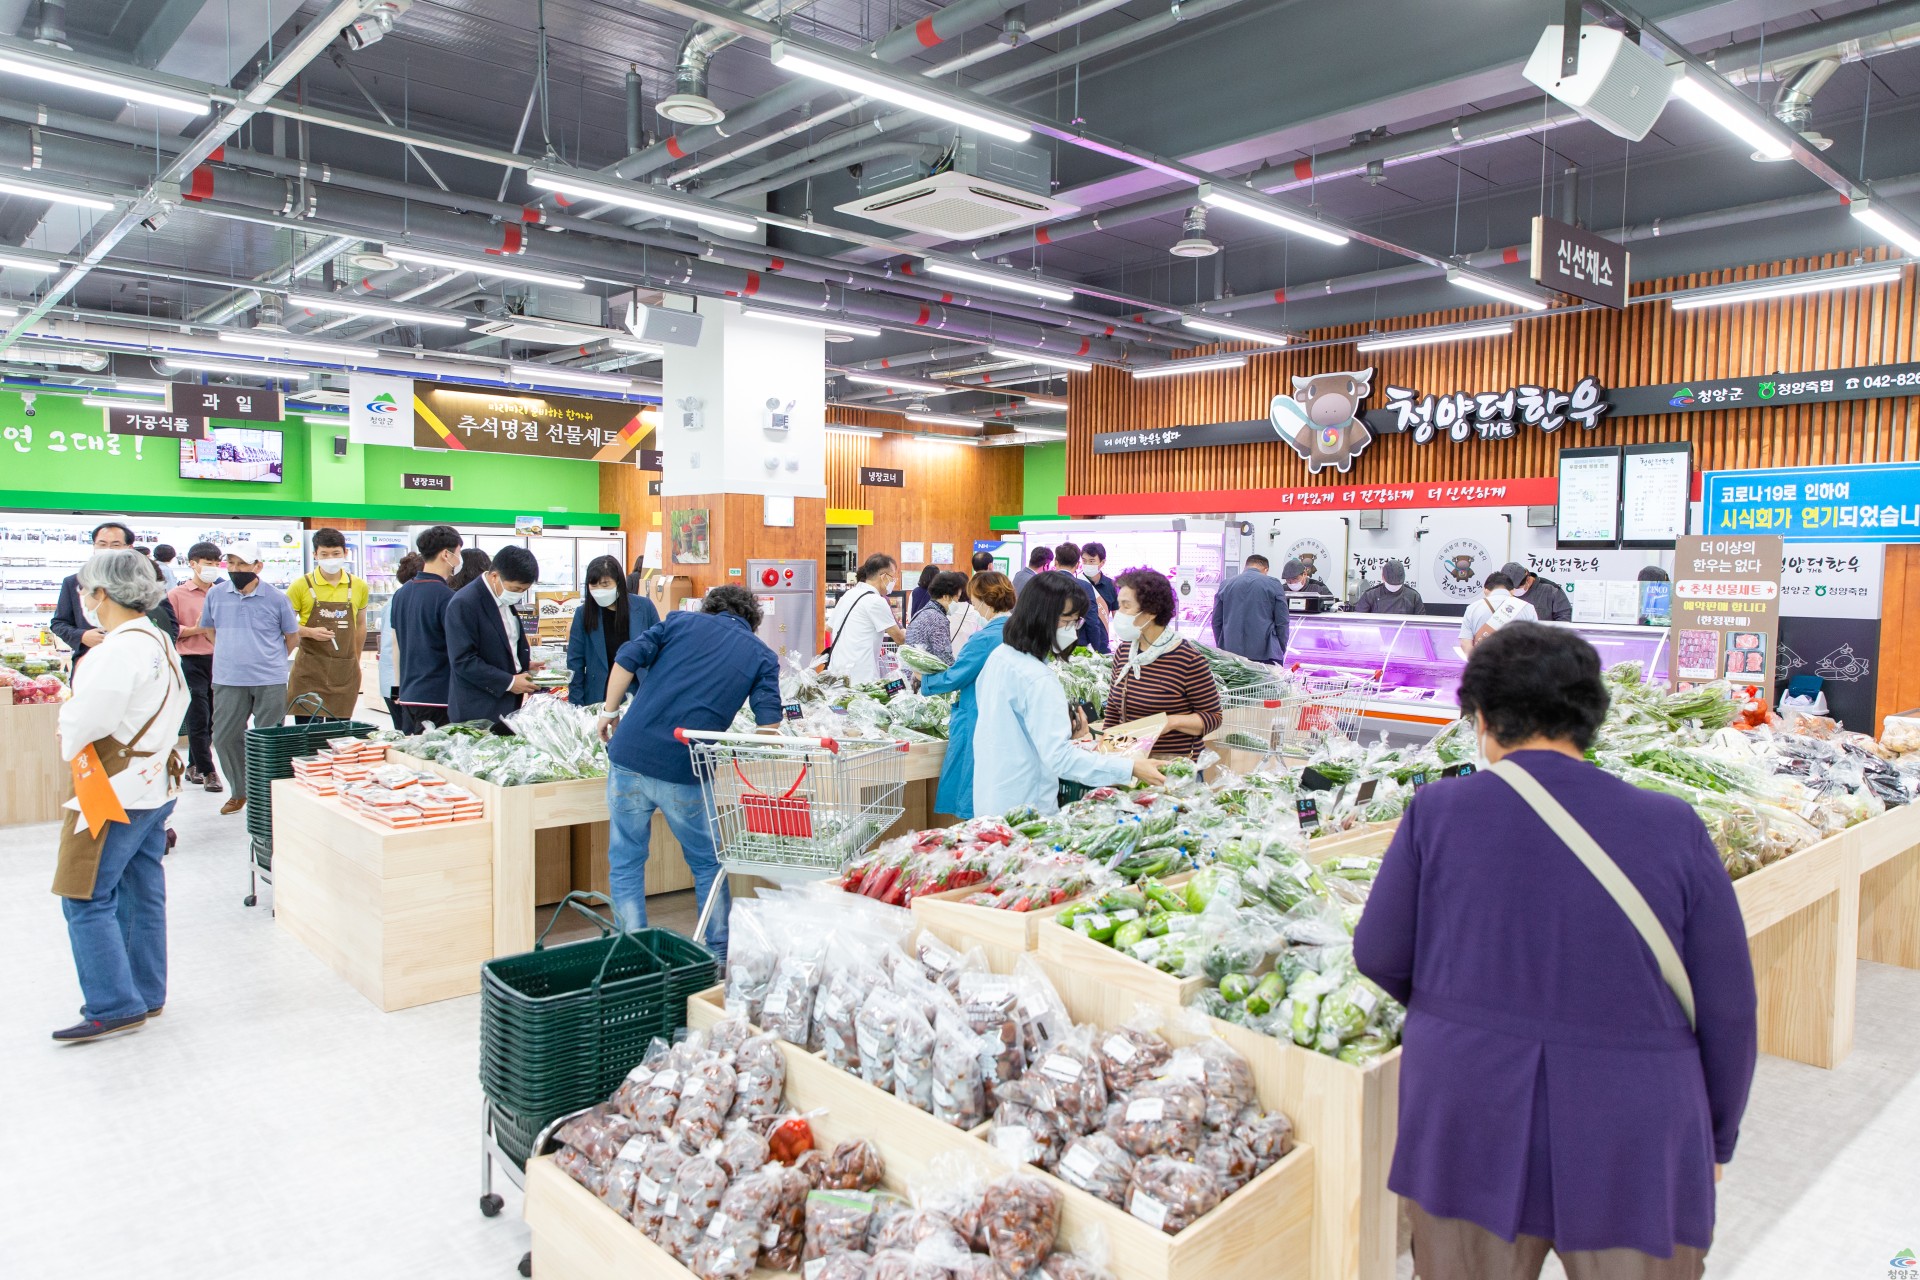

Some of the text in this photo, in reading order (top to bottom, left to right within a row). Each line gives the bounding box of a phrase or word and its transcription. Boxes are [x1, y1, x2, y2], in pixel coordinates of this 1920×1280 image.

[1557, 239, 1613, 286] 신선채소
[1863, 372, 1920, 389] 042-826
[1698, 379, 1834, 403] 청양군 청양축협
[1386, 376, 1605, 443] 청양더한우
[126, 414, 190, 432] 가공식품
[457, 414, 620, 448] 추석명절 선물세트
[1476, 423, 1513, 438] THE
[47, 430, 122, 456] 그대로
[1114, 435, 1137, 447] 이상의
[1139, 432, 1160, 446] 한우는
[1162, 430, 1181, 444] 없다
[412, 477, 443, 488] 냉장코너
[868, 471, 897, 483] 냉장코너
[1282, 485, 1507, 505] 더 맛있게 더 건강하게 더 신선하게
[1720, 482, 1850, 503] 코로나19로 인하여
[1720, 507, 1793, 530] 시식회가
[1701, 540, 1756, 555] 더 이상의
[1527, 553, 1600, 573] 청양더한우
[1693, 558, 1762, 573] 한우는 없다
[1715, 583, 1762, 596] 선물세트
[1683, 600, 1767, 613] 예약판매 합니다
